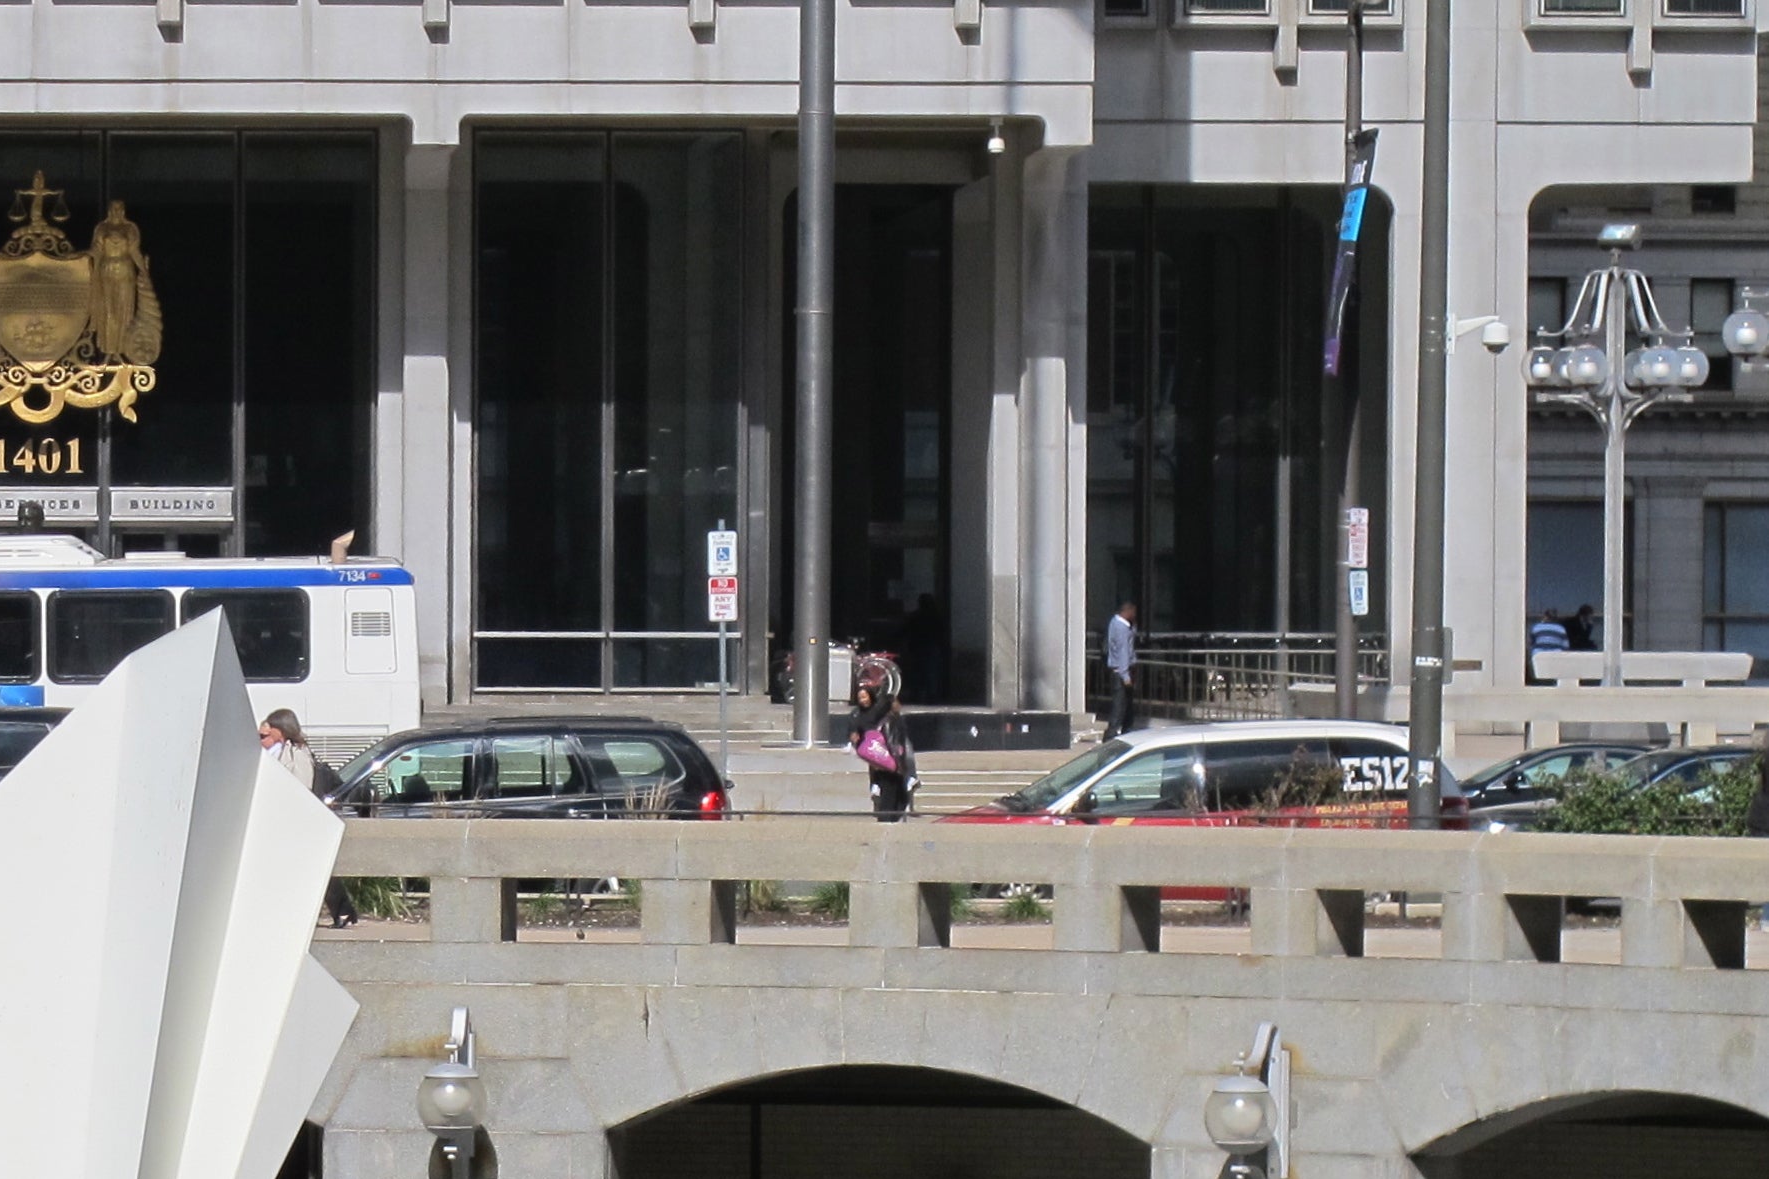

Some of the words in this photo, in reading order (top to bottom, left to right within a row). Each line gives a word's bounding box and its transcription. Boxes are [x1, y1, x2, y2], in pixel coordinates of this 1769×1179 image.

[129, 499, 216, 510] BUILDING
[338, 570, 366, 582] 7134
[1340, 757, 1409, 792] ES12
